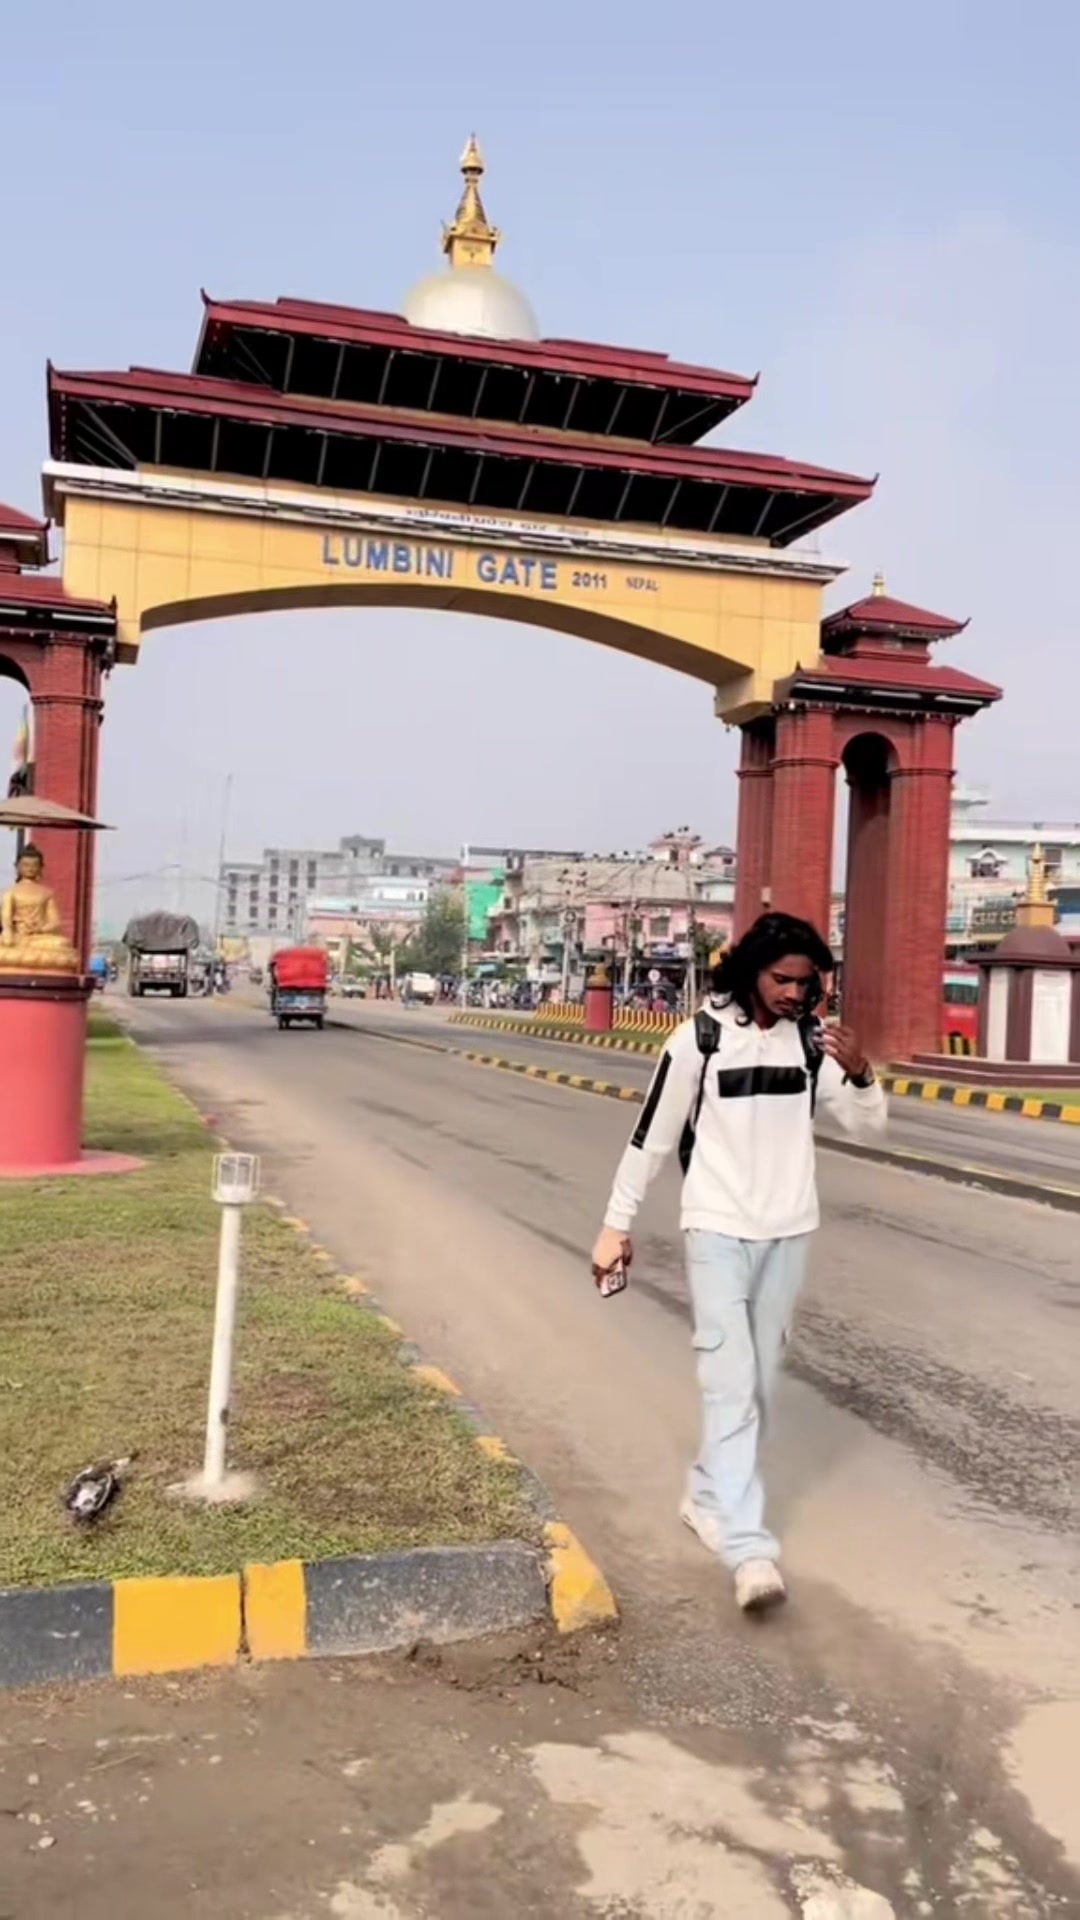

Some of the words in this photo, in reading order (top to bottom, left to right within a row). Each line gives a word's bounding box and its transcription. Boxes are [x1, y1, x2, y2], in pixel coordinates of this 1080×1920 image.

[322, 535, 452, 578] LUMBINI
[477, 554, 557, 590] GATE
[572, 571, 607, 588] 2011
[626, 576, 659, 592] NEPAL
